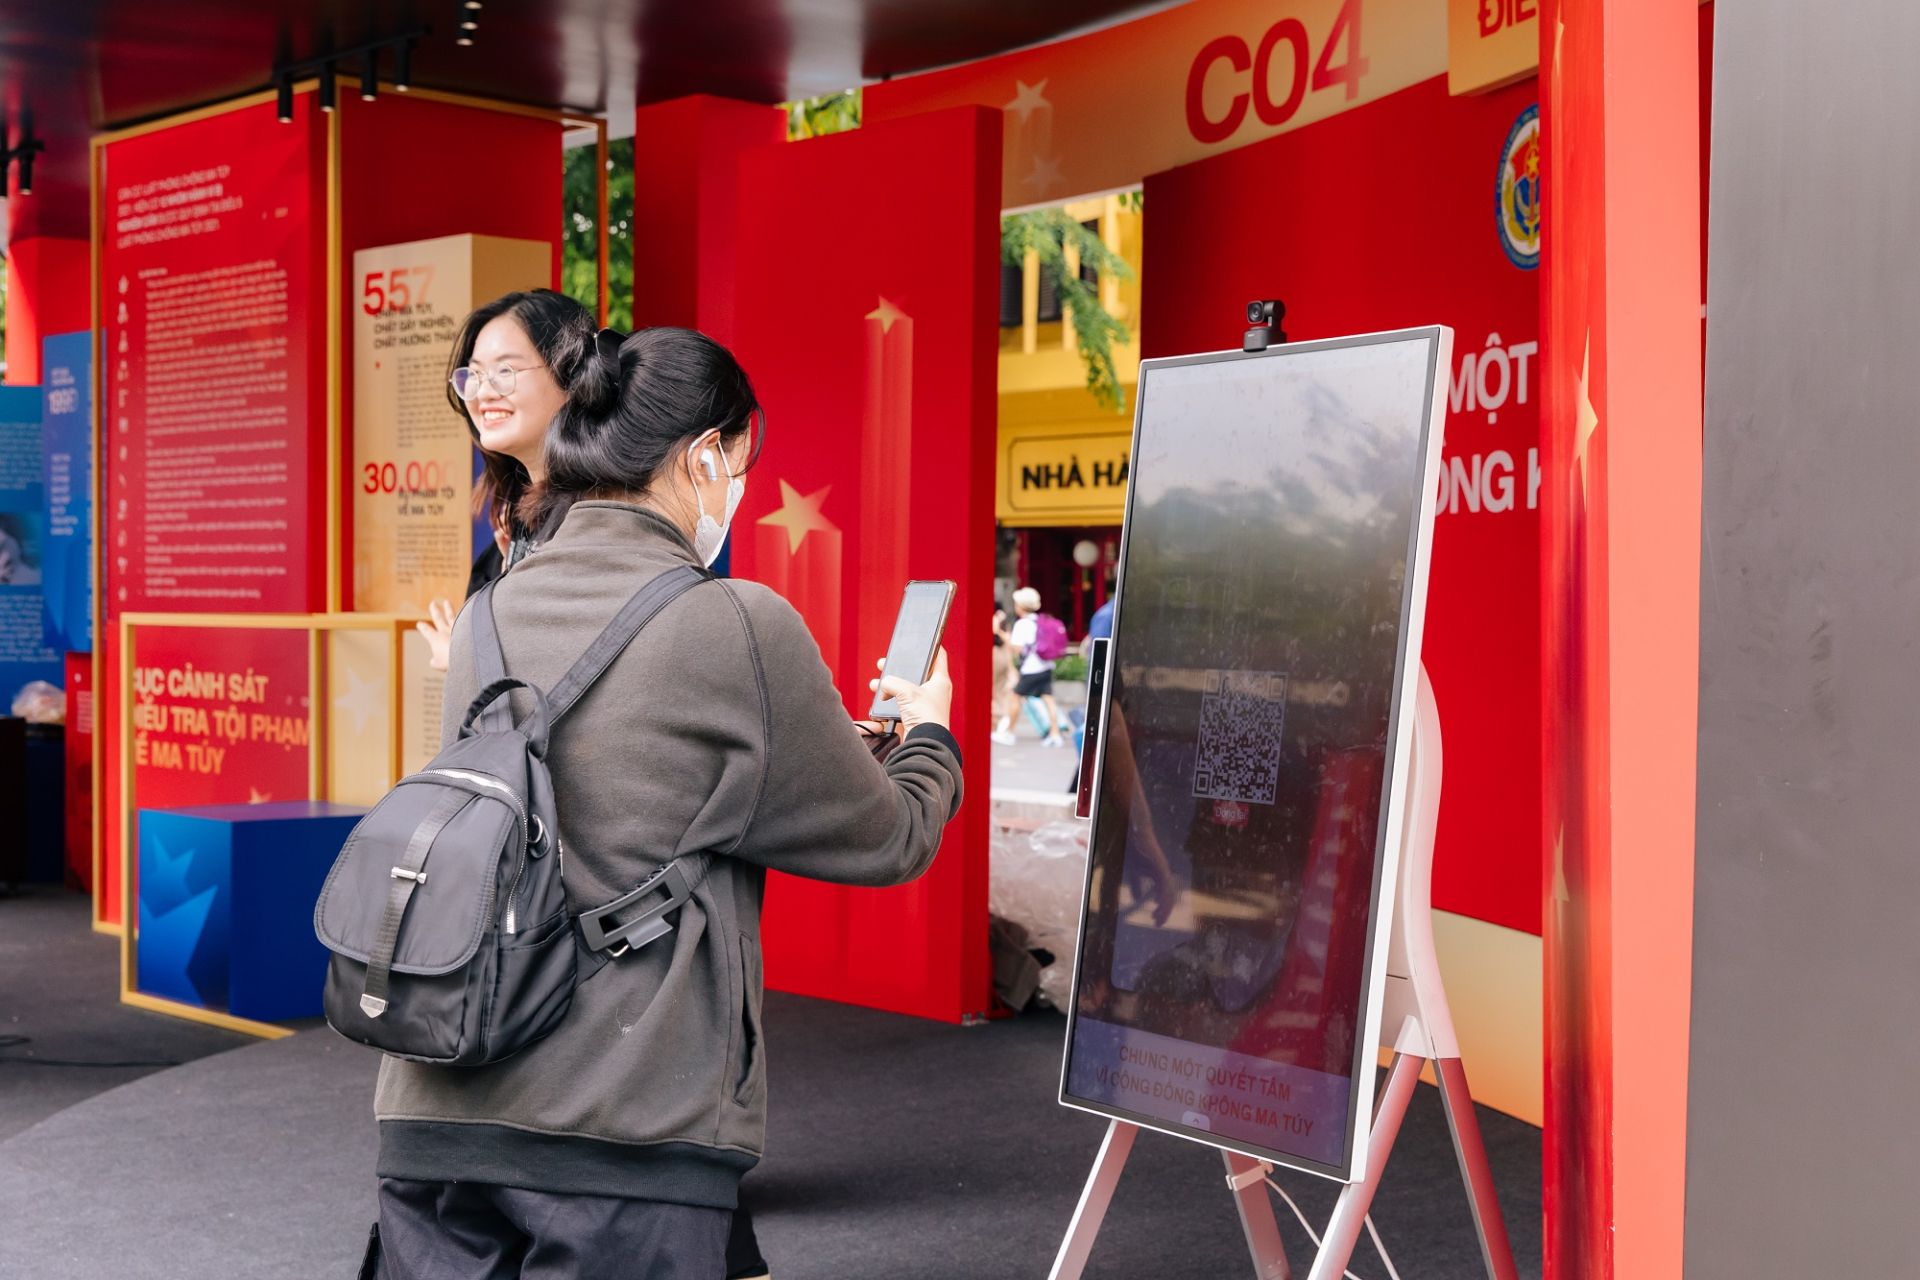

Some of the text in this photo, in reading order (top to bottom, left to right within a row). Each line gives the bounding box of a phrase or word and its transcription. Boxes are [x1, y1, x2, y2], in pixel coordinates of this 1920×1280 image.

[363, 265, 436, 316] 557
[1449, 332, 1538, 425] MỘT
[1022, 454, 1085, 490] NHÀ
[135, 662, 268, 703] ỤC CẢNH SÁT
[170, 705, 210, 737] TRA
[212, 703, 247, 746] TỘI
[251, 712, 309, 752] PHẠM
[151, 739, 183, 770] MA
[185, 738, 226, 776] TÚY
[1120, 1045, 1291, 1102] CHUNG MỘT QUYẾT TÂM
[1111, 1070, 1150, 1094] CỘNG
[1153, 1078, 1195, 1106] ĐỒNG
[1199, 1094, 1252, 1122] KHÔNG
[1256, 1107, 1278, 1128] MA
[1283, 1112, 1314, 1137] TÚY
